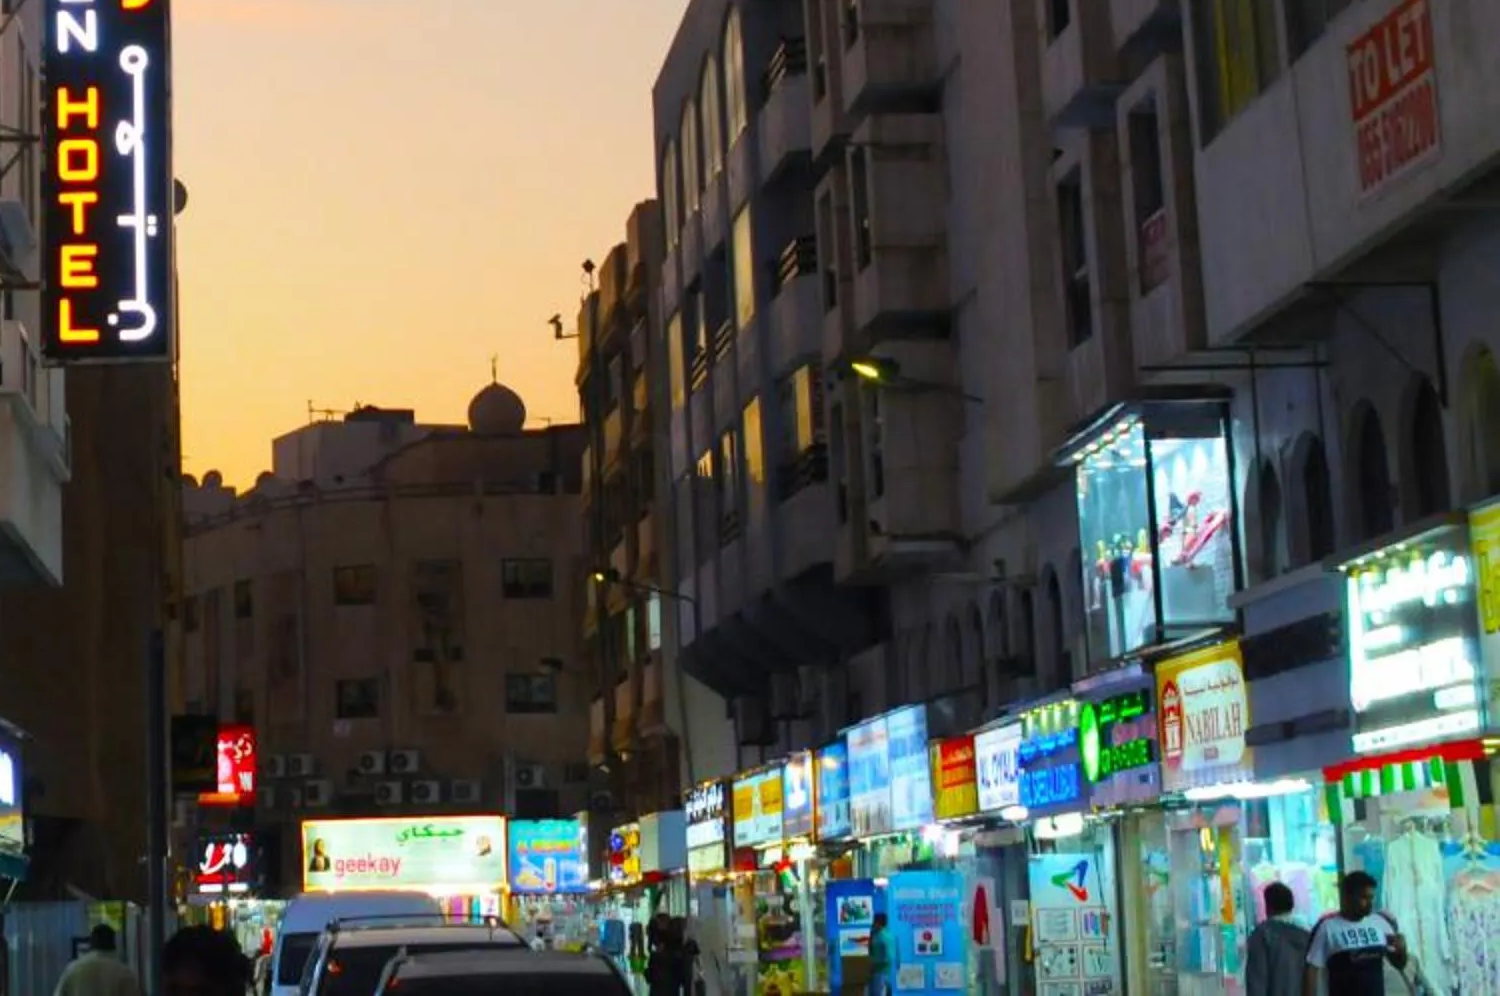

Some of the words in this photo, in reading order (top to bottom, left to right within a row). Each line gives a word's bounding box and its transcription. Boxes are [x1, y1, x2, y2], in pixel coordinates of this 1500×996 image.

[1350, 40, 1381, 109] TO
[1383, 0, 1427, 86] LET
[57, 86, 99, 342] HOTEL
[107, 45, 156, 341] معين
[1186, 702, 1243, 745] NABILAH
[334, 851, 402, 878] geekay
